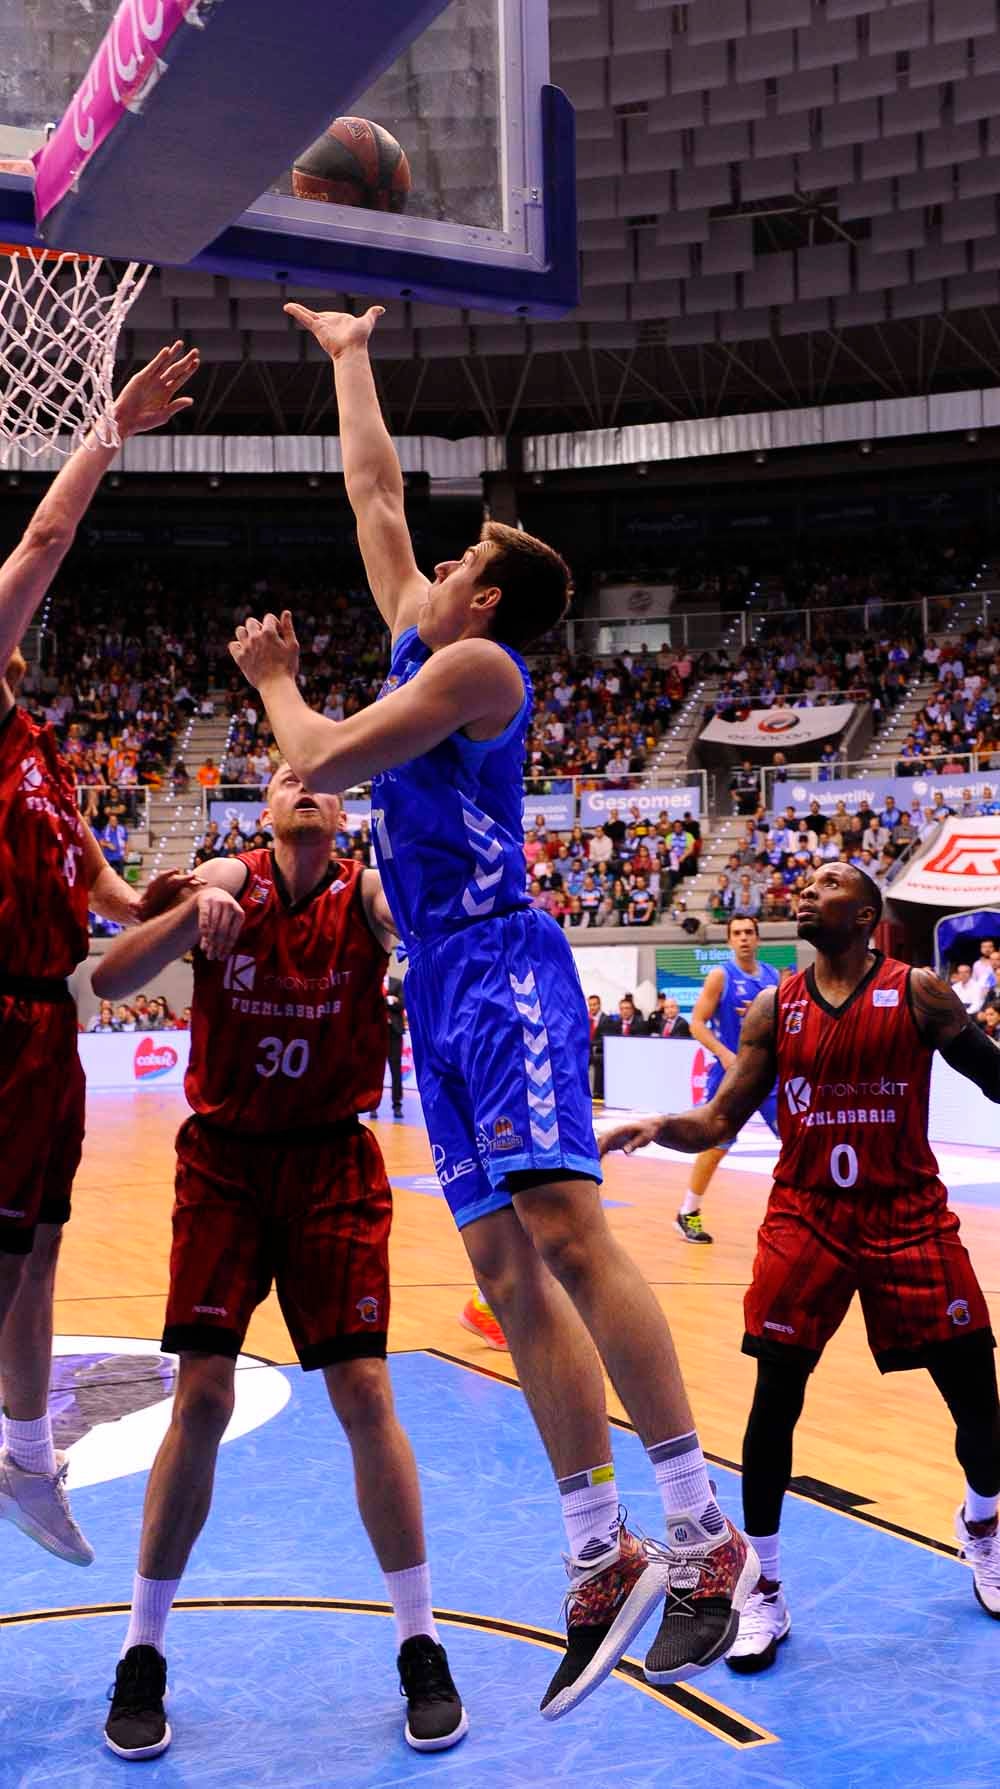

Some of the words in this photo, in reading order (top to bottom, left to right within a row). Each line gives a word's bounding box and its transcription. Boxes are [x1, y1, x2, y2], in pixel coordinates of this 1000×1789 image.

[588, 793, 692, 811] Gescomes
[255, 1036, 310, 1079] 30
[830, 1143, 858, 1188] 0
